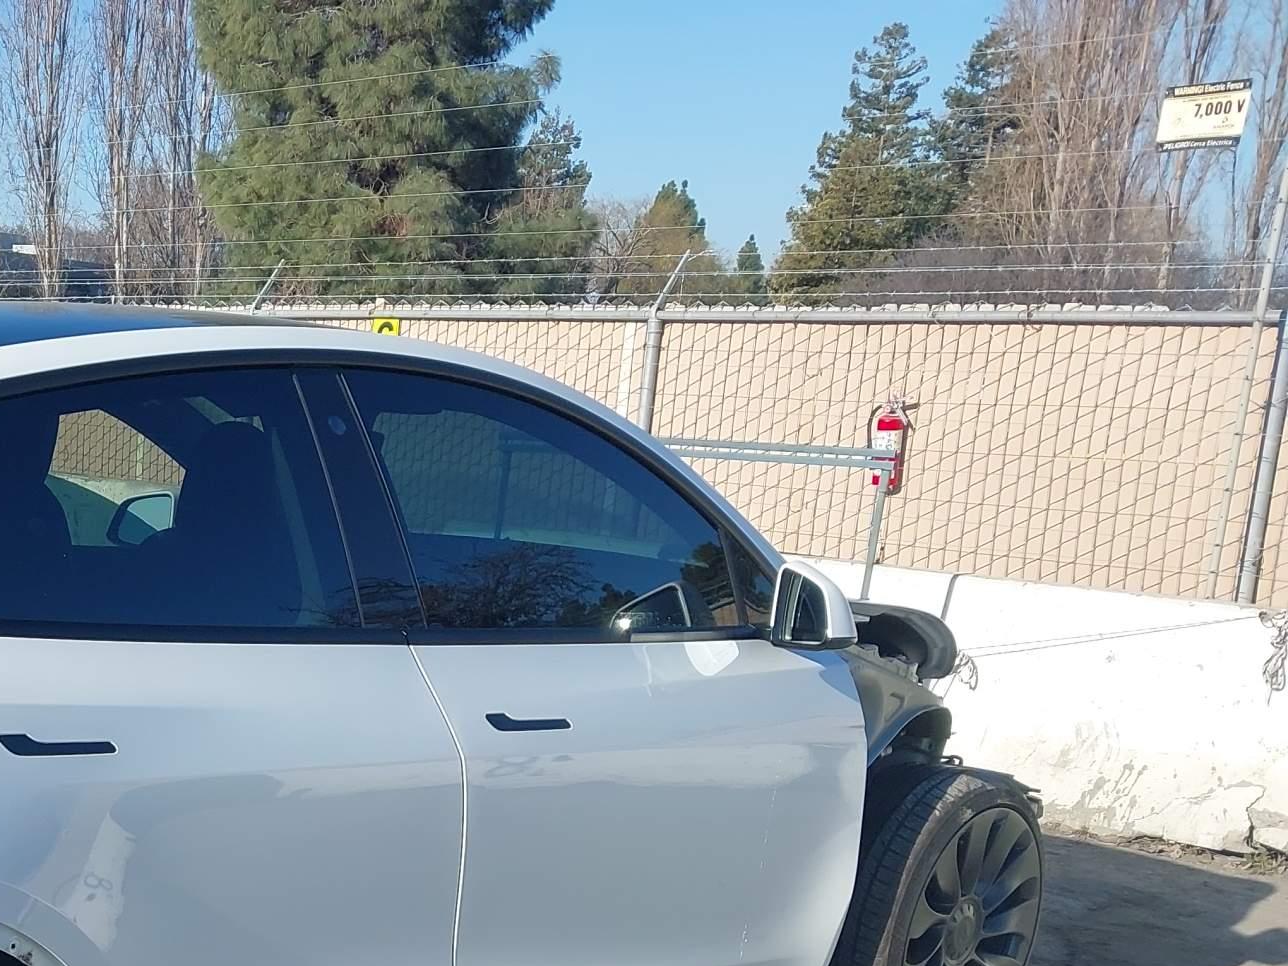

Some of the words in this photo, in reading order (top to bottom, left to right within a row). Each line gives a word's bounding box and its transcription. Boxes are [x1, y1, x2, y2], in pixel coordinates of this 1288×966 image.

[1174, 86, 1204, 96] WARNING!
[1205, 83, 1225, 93] Electric
[1226, 82, 1244, 90] Fence
[1194, 100, 1232, 118] 7,000
[1237, 99, 1245, 112] V
